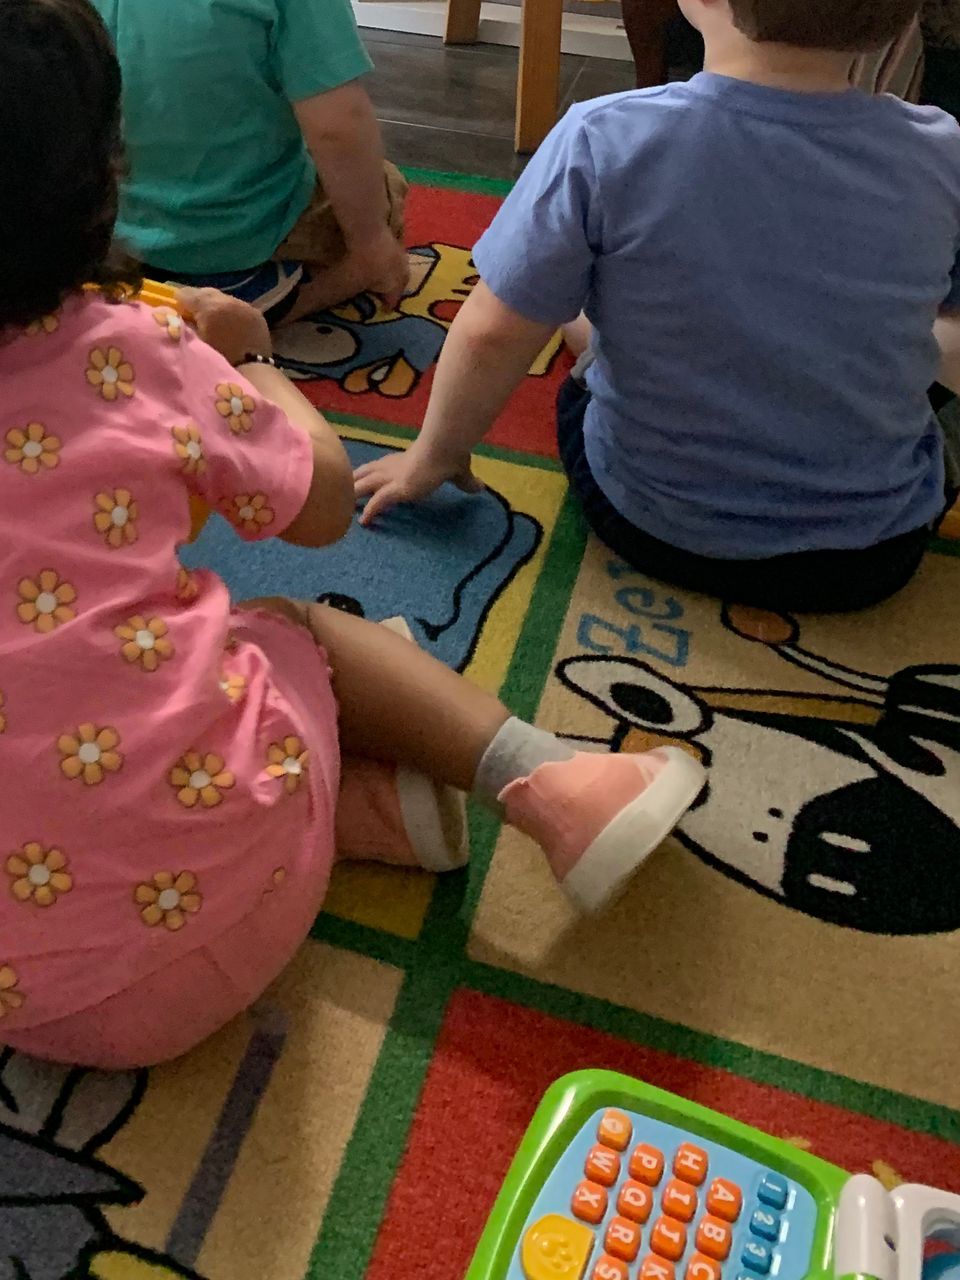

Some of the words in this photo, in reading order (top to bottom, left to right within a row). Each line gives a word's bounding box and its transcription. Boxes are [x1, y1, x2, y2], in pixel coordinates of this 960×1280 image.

[591, 1150, 616, 1174] W
[637, 1151, 658, 1170] P
[680, 1150, 705, 1170] H
[578, 1187, 602, 1208] X
[623, 1187, 647, 1207] Q
[669, 1187, 690, 1205] I
[713, 1186, 736, 1204] A
[756, 1210, 775, 1226] 2
[611, 1224, 635, 1244] R
[659, 1223, 681, 1243] J
[703, 1223, 726, 1243] B
[746, 1242, 767, 1258] 3
